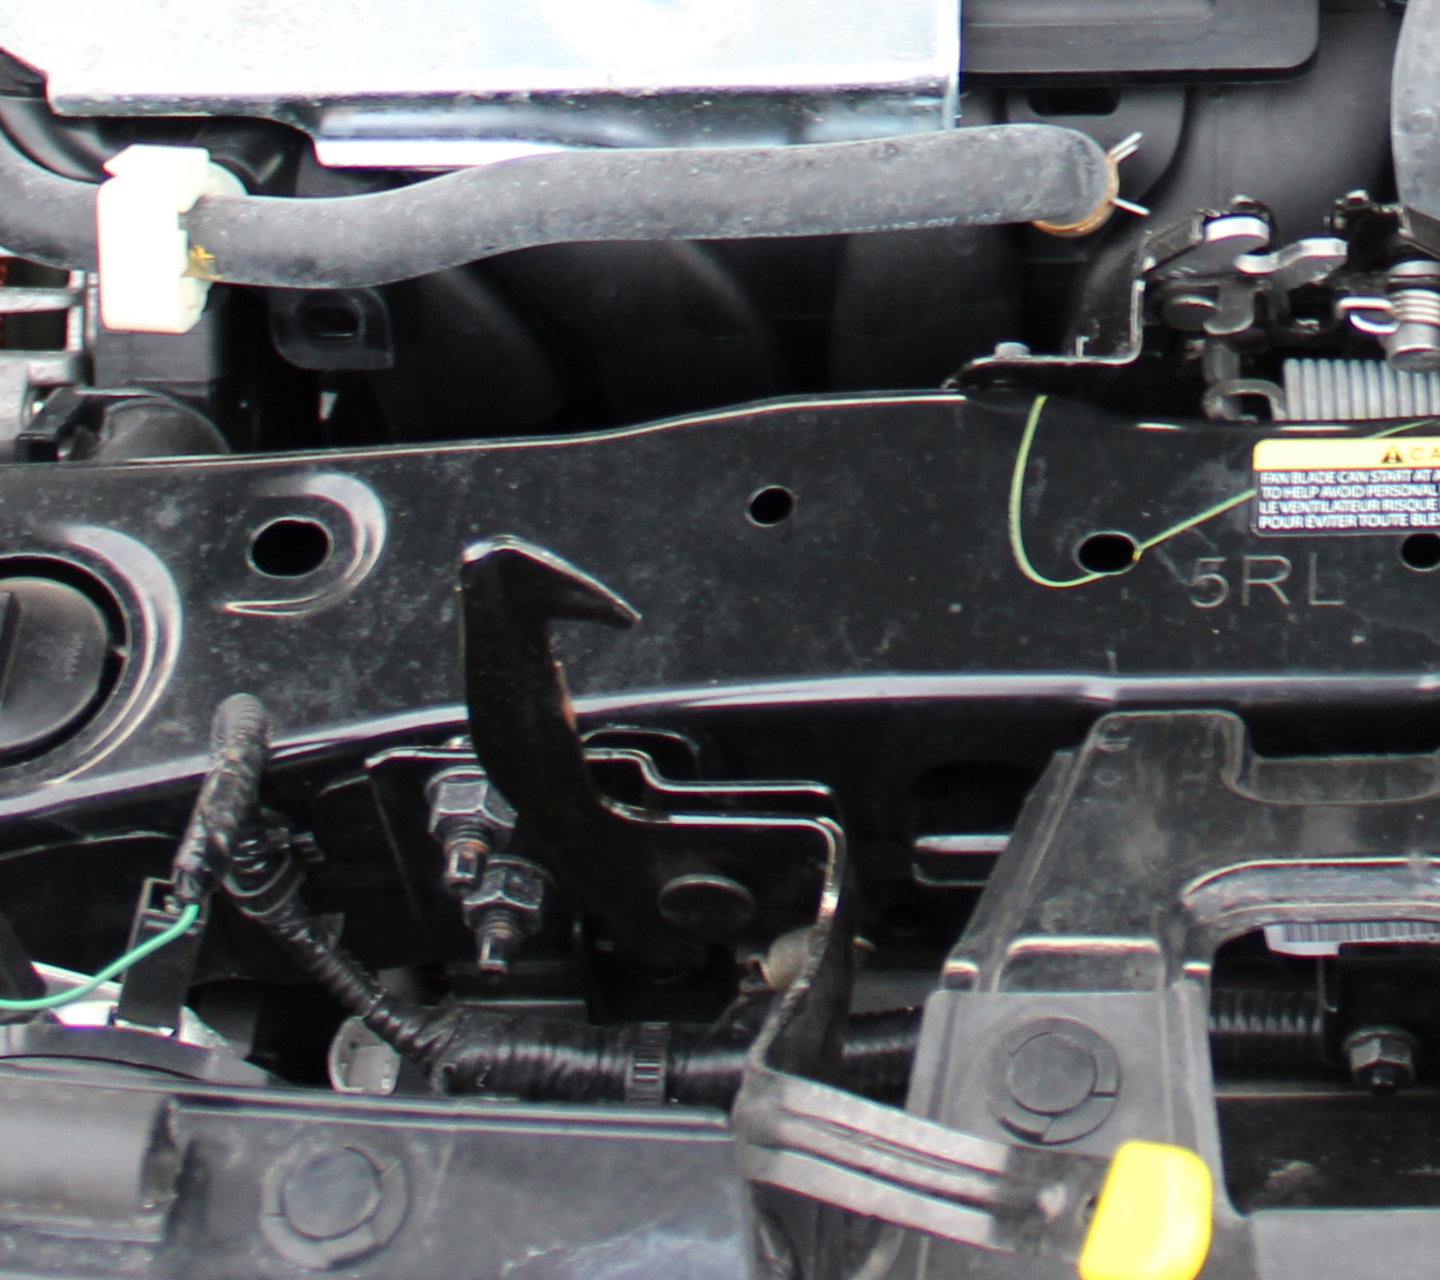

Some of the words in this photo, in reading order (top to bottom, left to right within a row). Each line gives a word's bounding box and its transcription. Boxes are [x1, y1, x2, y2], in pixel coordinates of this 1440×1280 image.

[1290, 470, 1336, 484] BLADE
[1337, 470, 1369, 483] CAN
[1369, 469, 1412, 483] START
[1412, 469, 1431, 481] AT
[1262, 485, 1282, 499] TO
[1282, 485, 1319, 499] HELP
[1320, 484, 1365, 498] AVOID
[1365, 483, 1439, 497] PERSONAL
[1259, 500, 1279, 514] LE
[1279, 499, 1380, 513] VENTILATEUR
[1381, 498, 1439, 512] RISQUE
[1258, 514, 1304, 529] POUR
[1358, 513, 1410, 528] TOUTE
[1187, 552, 1347, 608] 5RL
